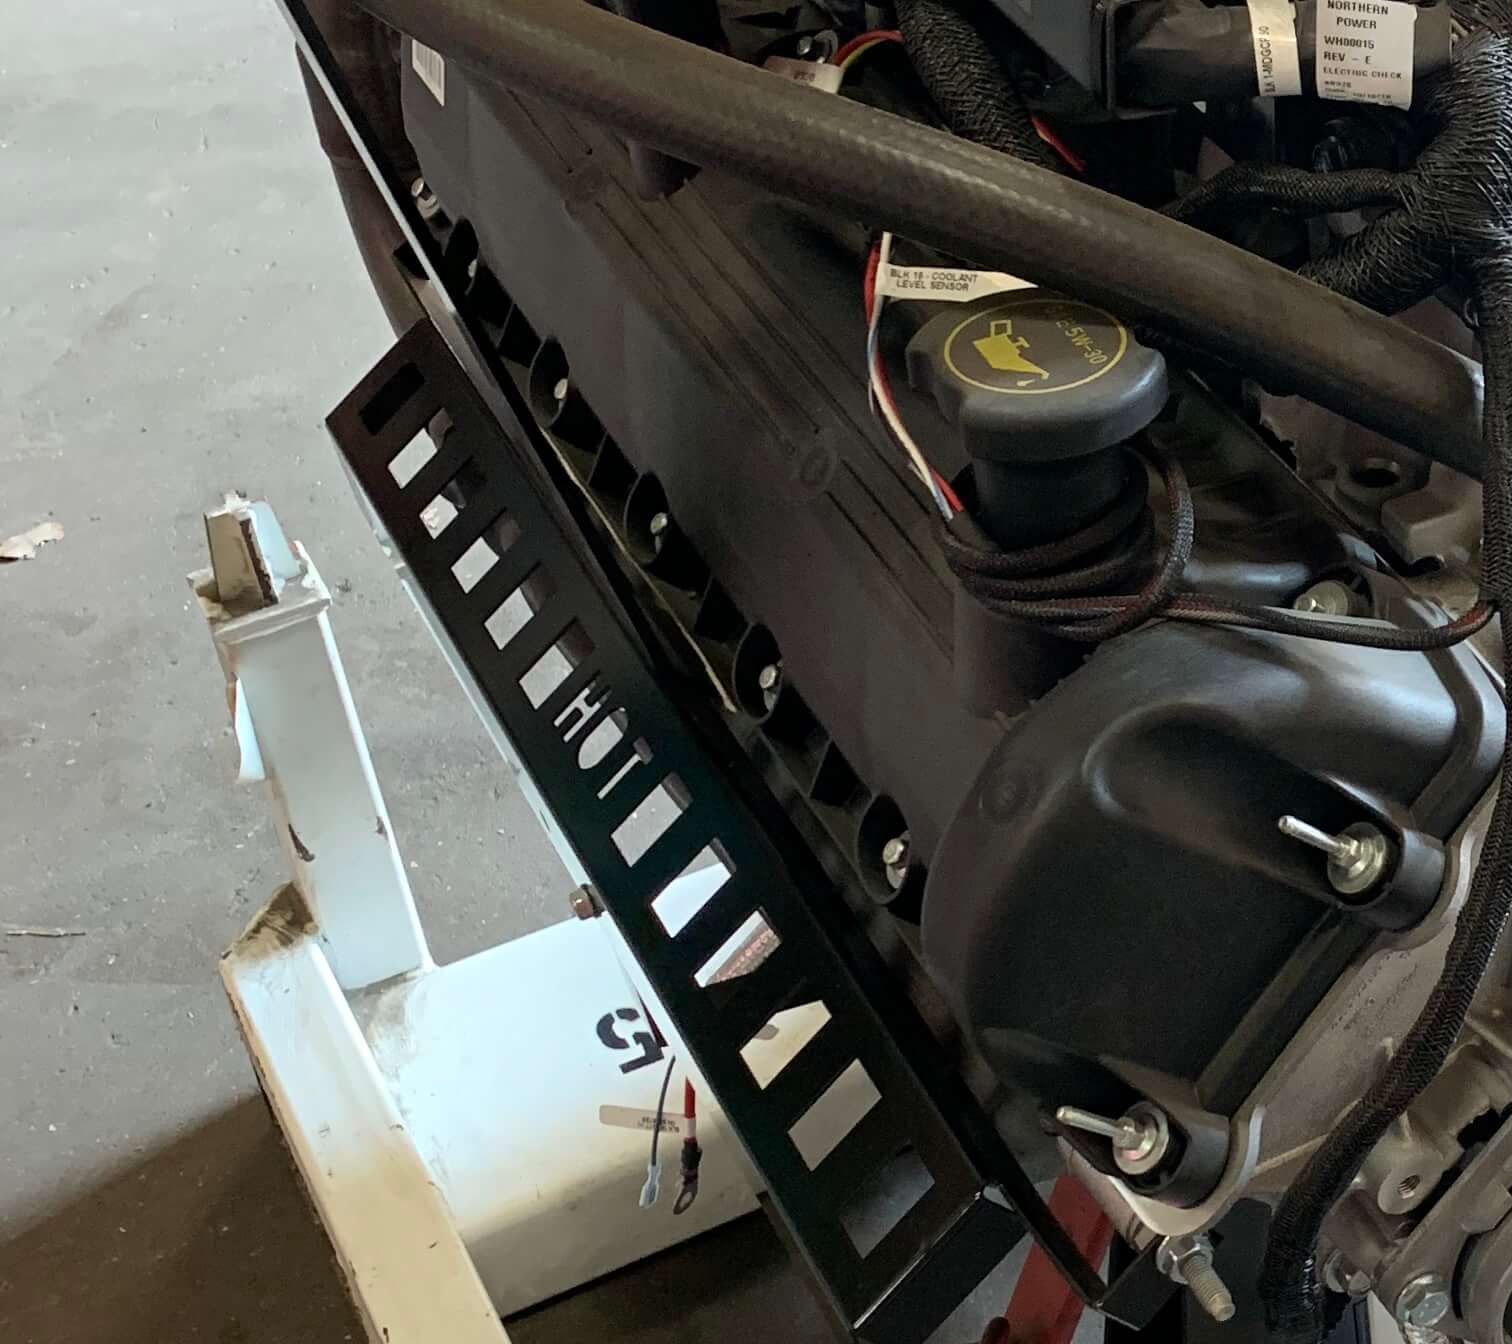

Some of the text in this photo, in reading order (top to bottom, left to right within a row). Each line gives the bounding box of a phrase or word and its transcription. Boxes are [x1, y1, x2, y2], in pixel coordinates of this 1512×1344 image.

[1327, 0, 1389, 15] NORTHERN
[1336, 16, 1377, 29] POWER
[1323, 51, 1346, 62] REV
[1364, 55, 1373, 65] E
[931, 271, 978, 283] COOLANT
[895, 279, 969, 292] LEVEL SENSOR
[1063, 325, 1110, 365] 5W-30
[553, 681, 655, 800] HOT
